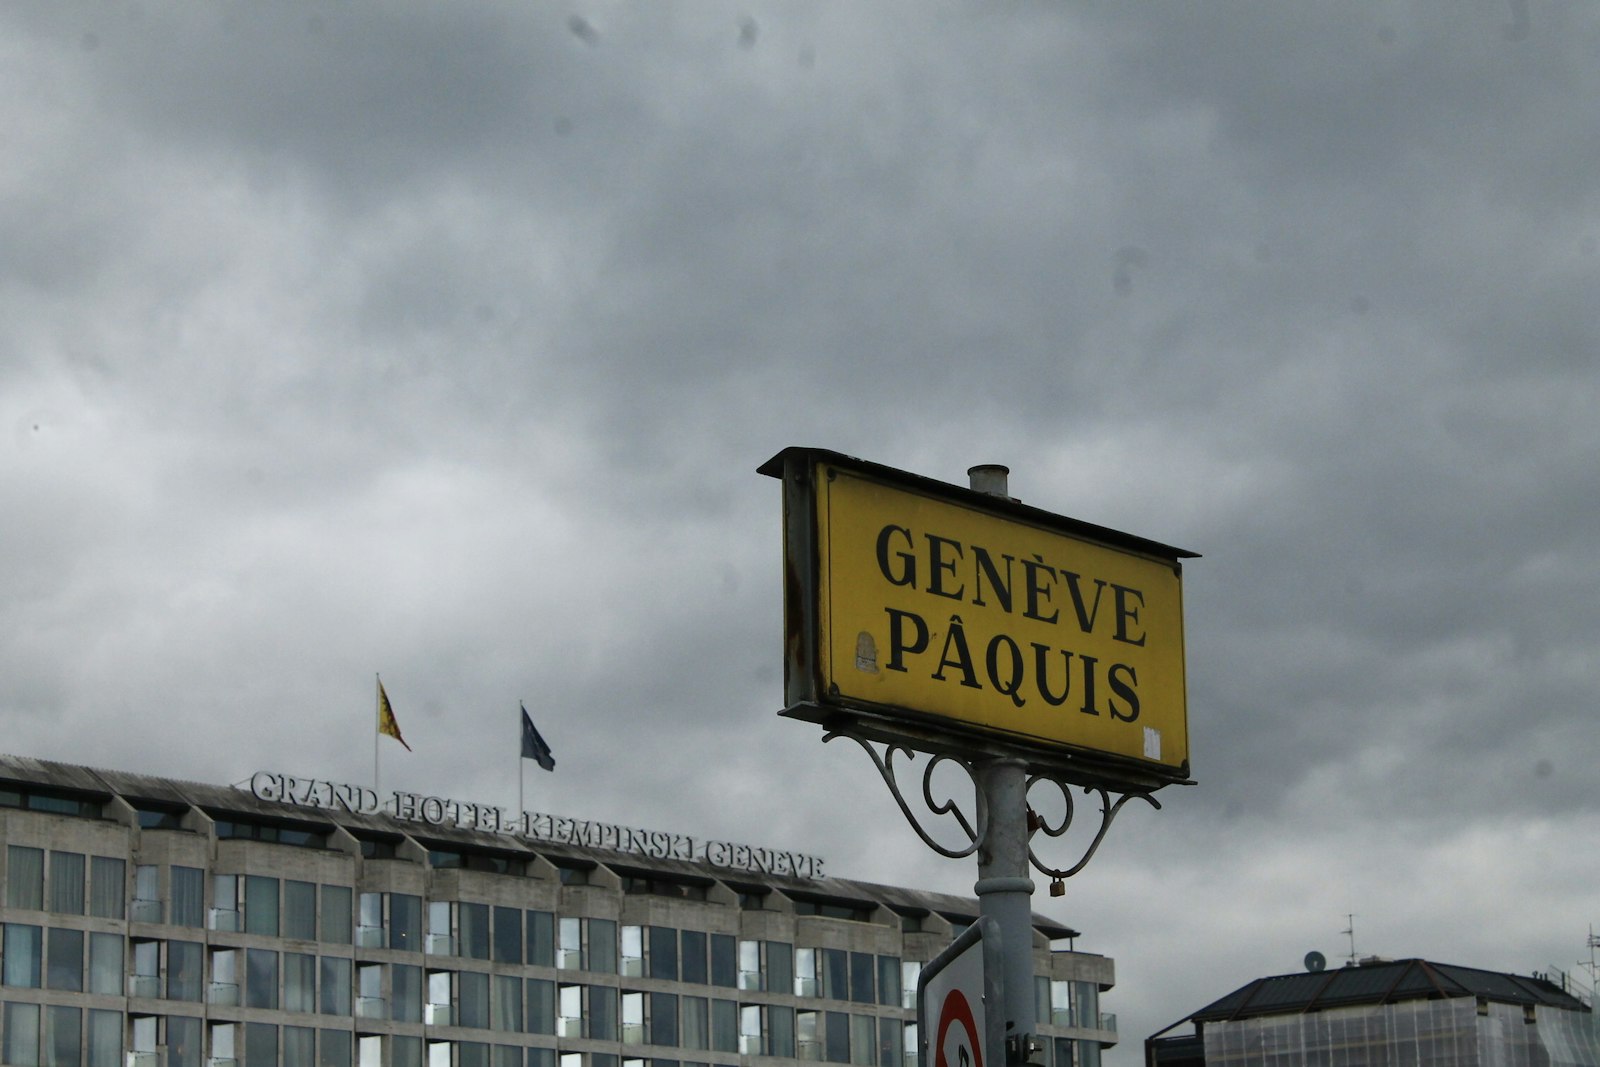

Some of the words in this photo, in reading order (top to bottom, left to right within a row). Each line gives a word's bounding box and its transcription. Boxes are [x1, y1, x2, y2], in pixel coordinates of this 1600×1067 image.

[876, 524, 1146, 647] GENÈVE
[885, 607, 1141, 723] PÂQUIS
[251, 771, 379, 815] GRAND
[393, 791, 514, 835] HOTEL
[523, 811, 701, 863] KEMPINSKI
[705, 841, 825, 880] GENEVE
